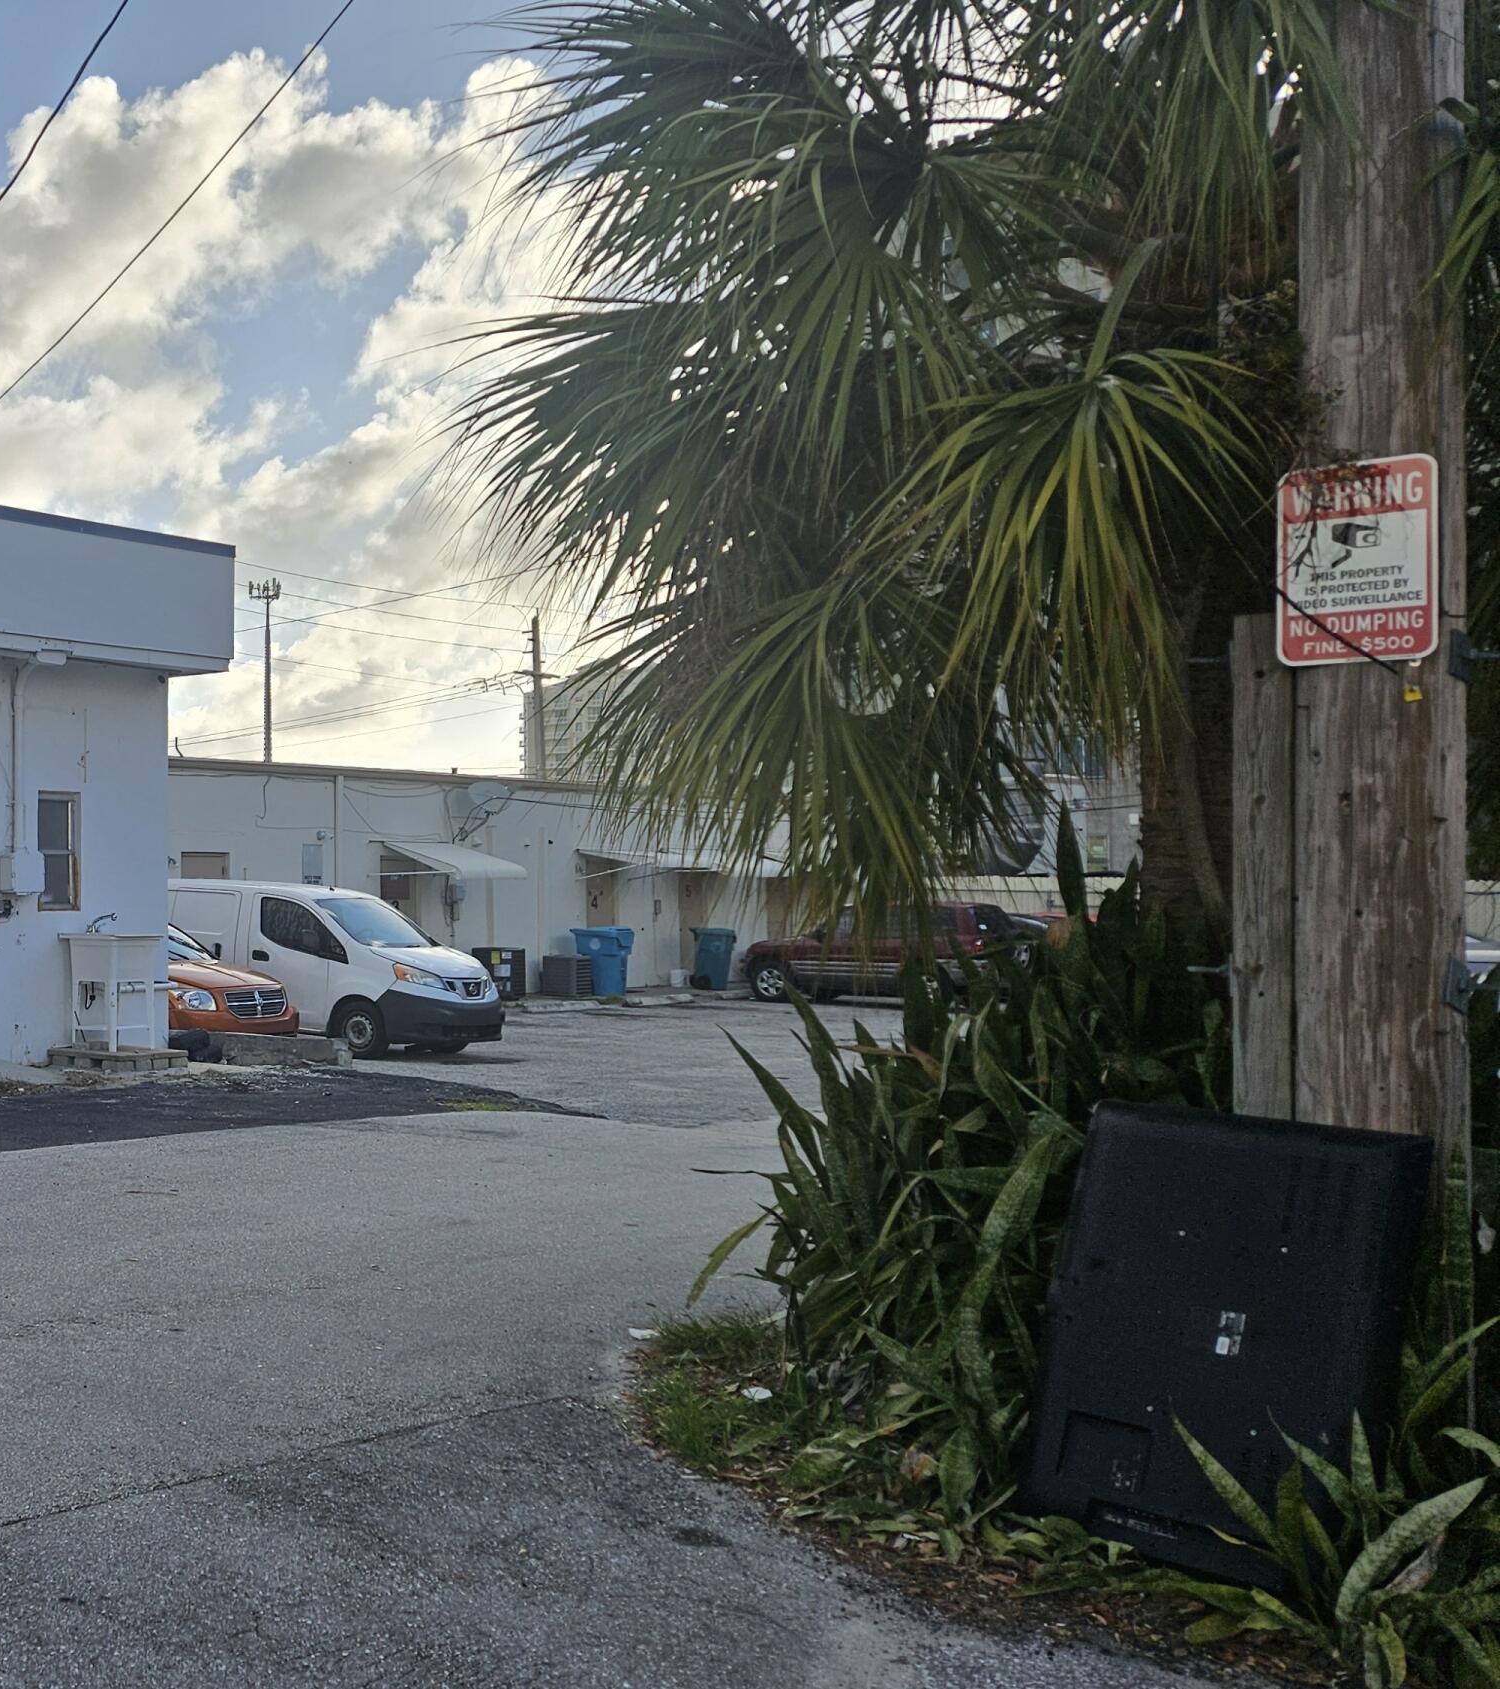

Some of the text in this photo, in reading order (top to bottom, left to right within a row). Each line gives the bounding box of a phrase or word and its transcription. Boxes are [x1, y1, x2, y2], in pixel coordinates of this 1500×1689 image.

[1292, 471, 1424, 516] WRNING
[1310, 566, 1404, 582] THIS PROPERTY
[1305, 578, 1409, 596] IS PROTECTED BY
[1331, 590, 1423, 606] SURVEILLANCE
[1290, 610, 1425, 637] NO DUMPING
[1303, 635, 1415, 655] FINE $500
[590, 895, 599, 910] 4
